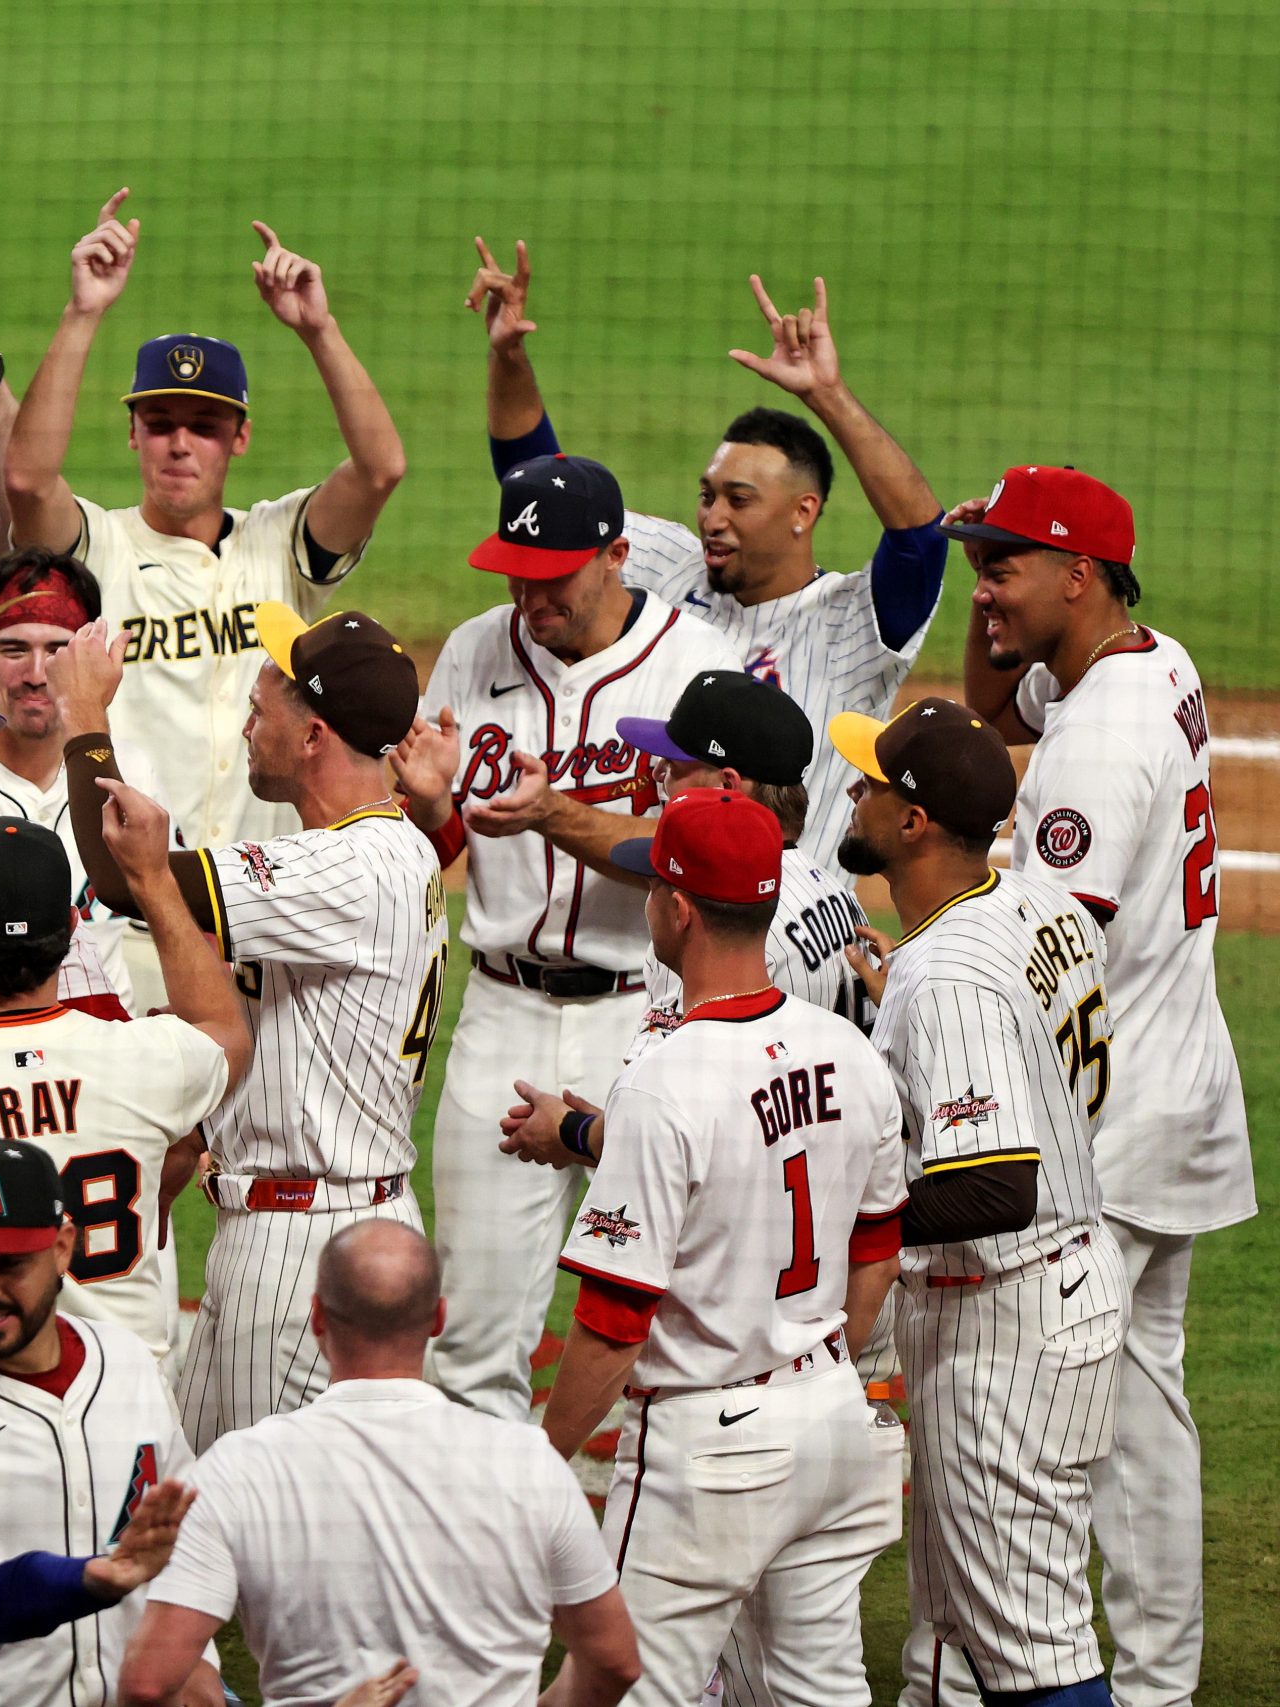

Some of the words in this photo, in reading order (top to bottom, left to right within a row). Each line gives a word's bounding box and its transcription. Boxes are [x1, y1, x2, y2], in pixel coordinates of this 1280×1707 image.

[507, 500, 540, 536] A
[121, 602, 267, 664] BREWE
[1040, 845, 1083, 866] NATIONALS
[1042, 810, 1089, 836] WASHINGTON
[1183, 766, 1218, 931] 2
[1025, 913, 1094, 1011] SUREZ
[1055, 985, 1112, 1120] 75
[751, 1062, 842, 1147] GORE
[775, 1149, 820, 1300] 1
